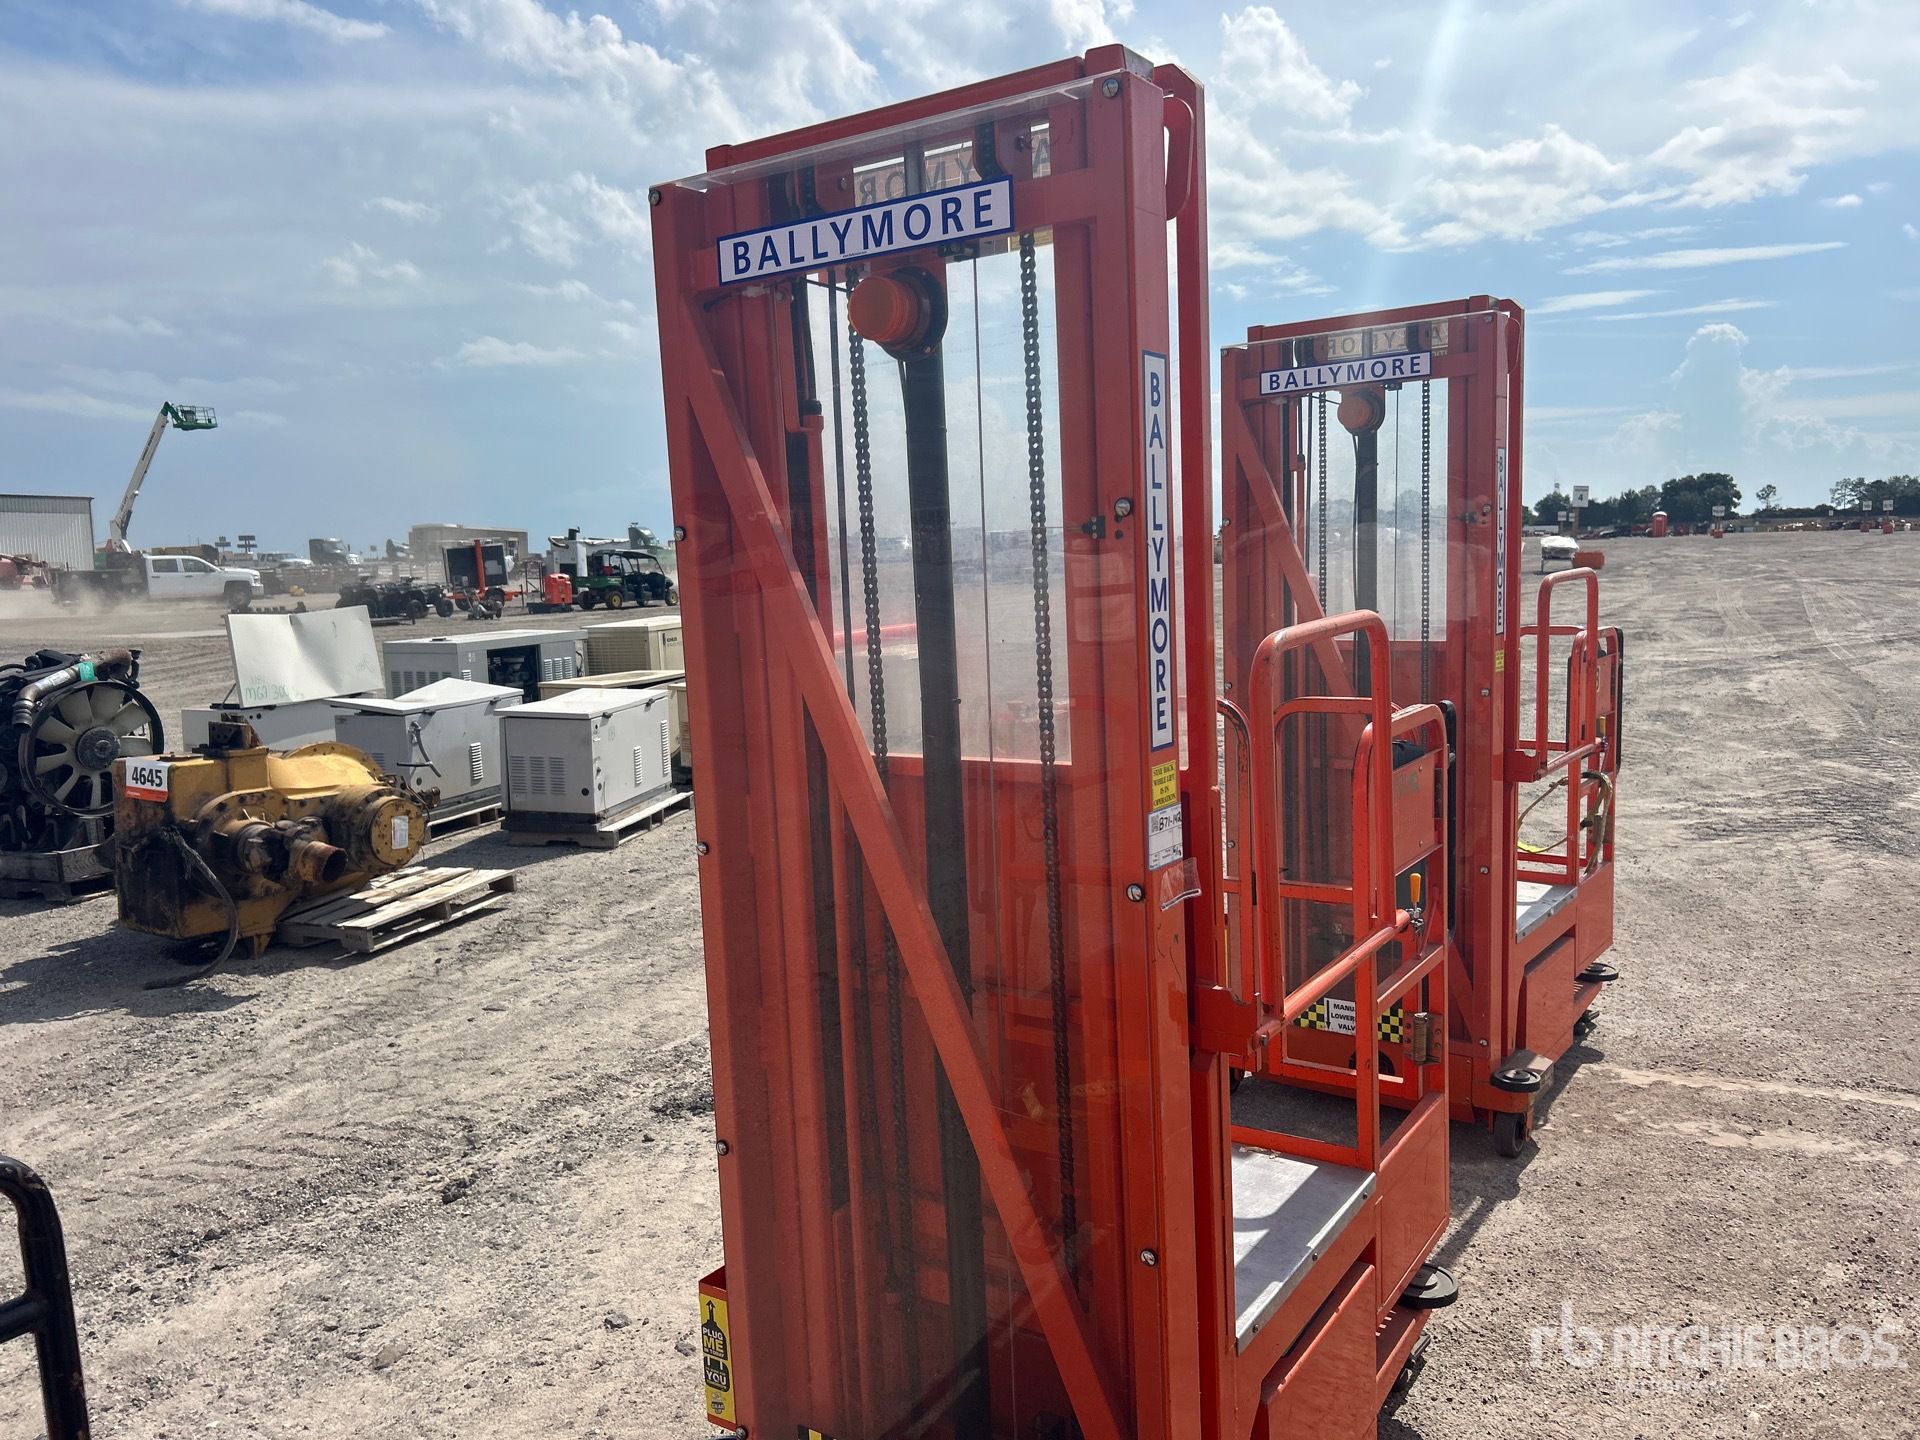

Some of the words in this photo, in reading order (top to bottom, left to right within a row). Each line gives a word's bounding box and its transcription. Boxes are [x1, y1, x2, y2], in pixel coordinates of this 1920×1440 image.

[733, 189, 993, 275] BALLYMORE
[1269, 356, 1421, 391] BALLYMORE
[1577, 493, 1583, 502] 4
[1148, 371, 1168, 731] BALLYMORE
[1153, 768, 1163, 776] STAY
[1163, 764, 1175, 773] BACK
[131, 766, 163, 788] 4645
[1166, 773, 1175, 782] LIFT
[1160, 787, 1165, 795] IS
[1153, 793, 1176, 806] OPERATION
[1333, 1003, 1355, 1011] MANU
[1331, 1013, 1355, 1022] LOWER
[1338, 1023, 1355, 1031] VALV
[702, 1327, 724, 1340] PLUG
[703, 1335, 724, 1353] ME
[706, 1370, 727, 1386] YOU
